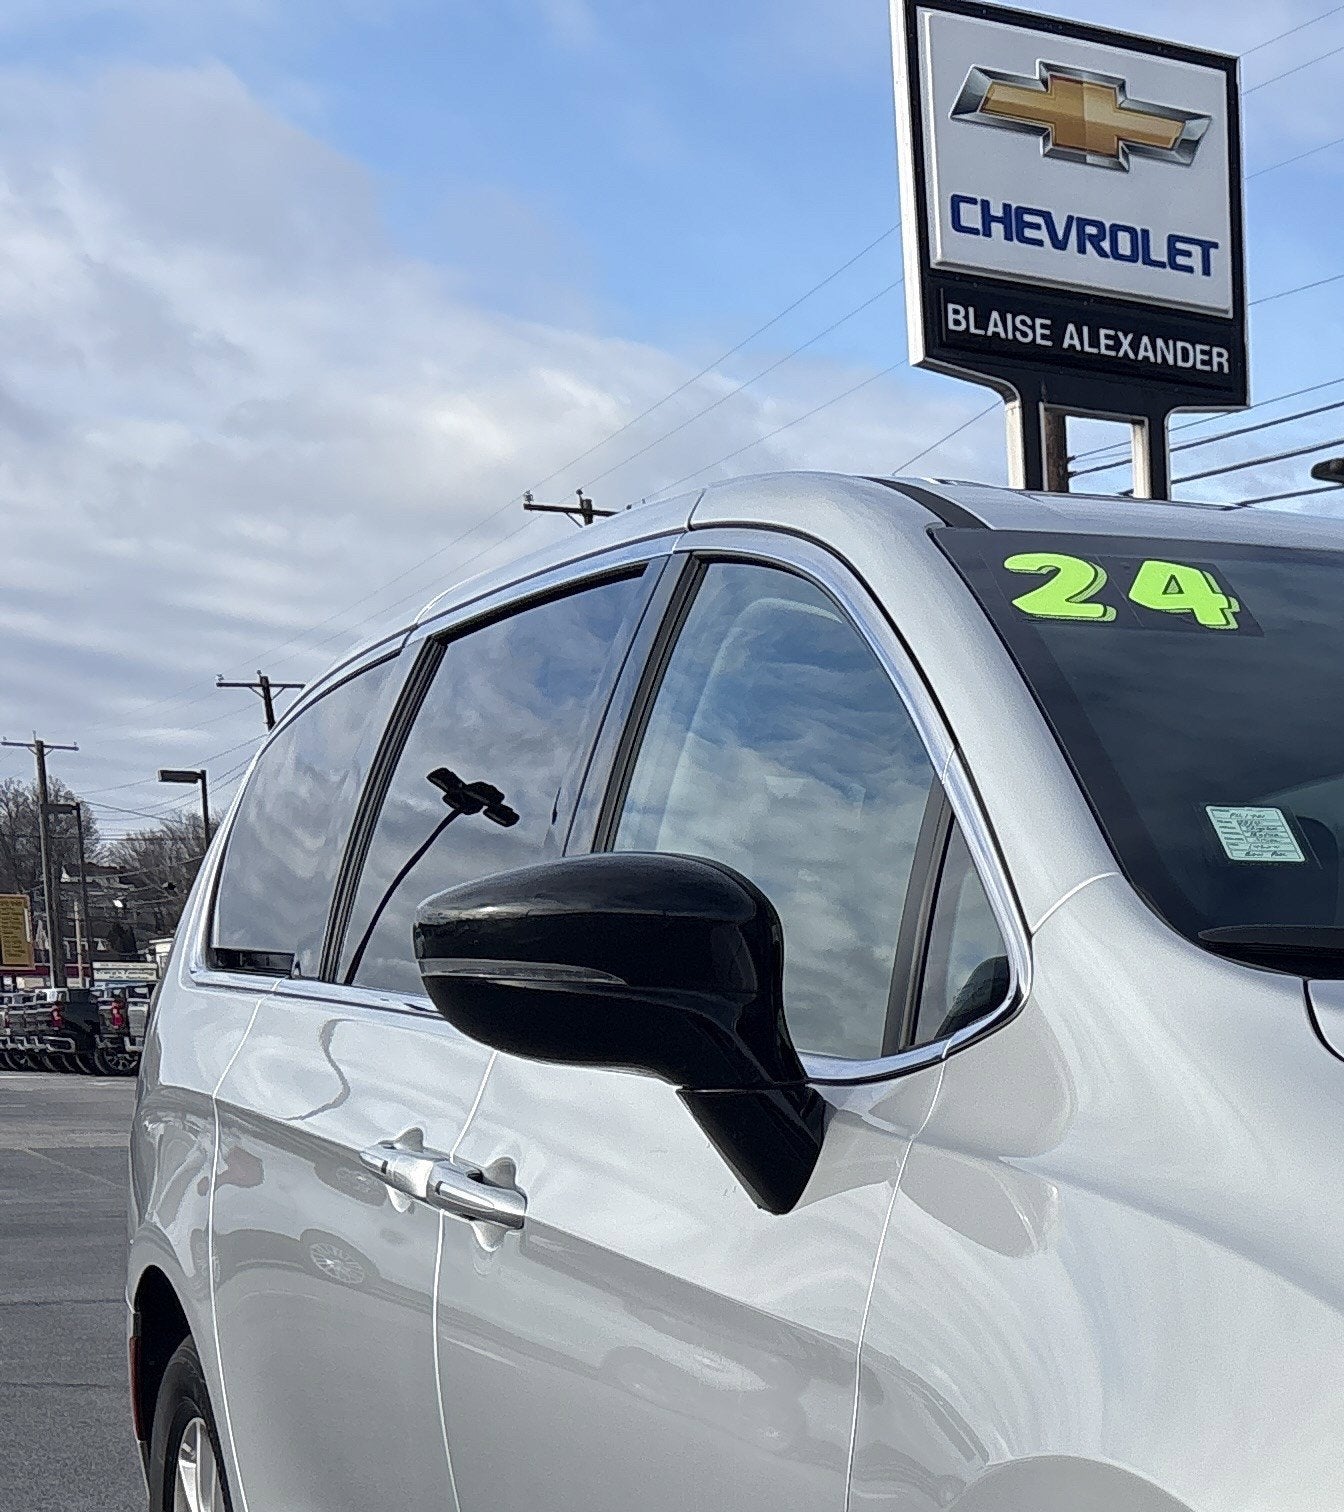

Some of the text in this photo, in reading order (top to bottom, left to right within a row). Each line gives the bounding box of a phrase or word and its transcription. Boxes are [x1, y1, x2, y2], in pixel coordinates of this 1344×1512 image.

[950, 193, 1219, 277] CHEVROLET
[947, 303, 1230, 374] BLAISE ALEXANDER
[1003, 552, 1240, 629] 24
